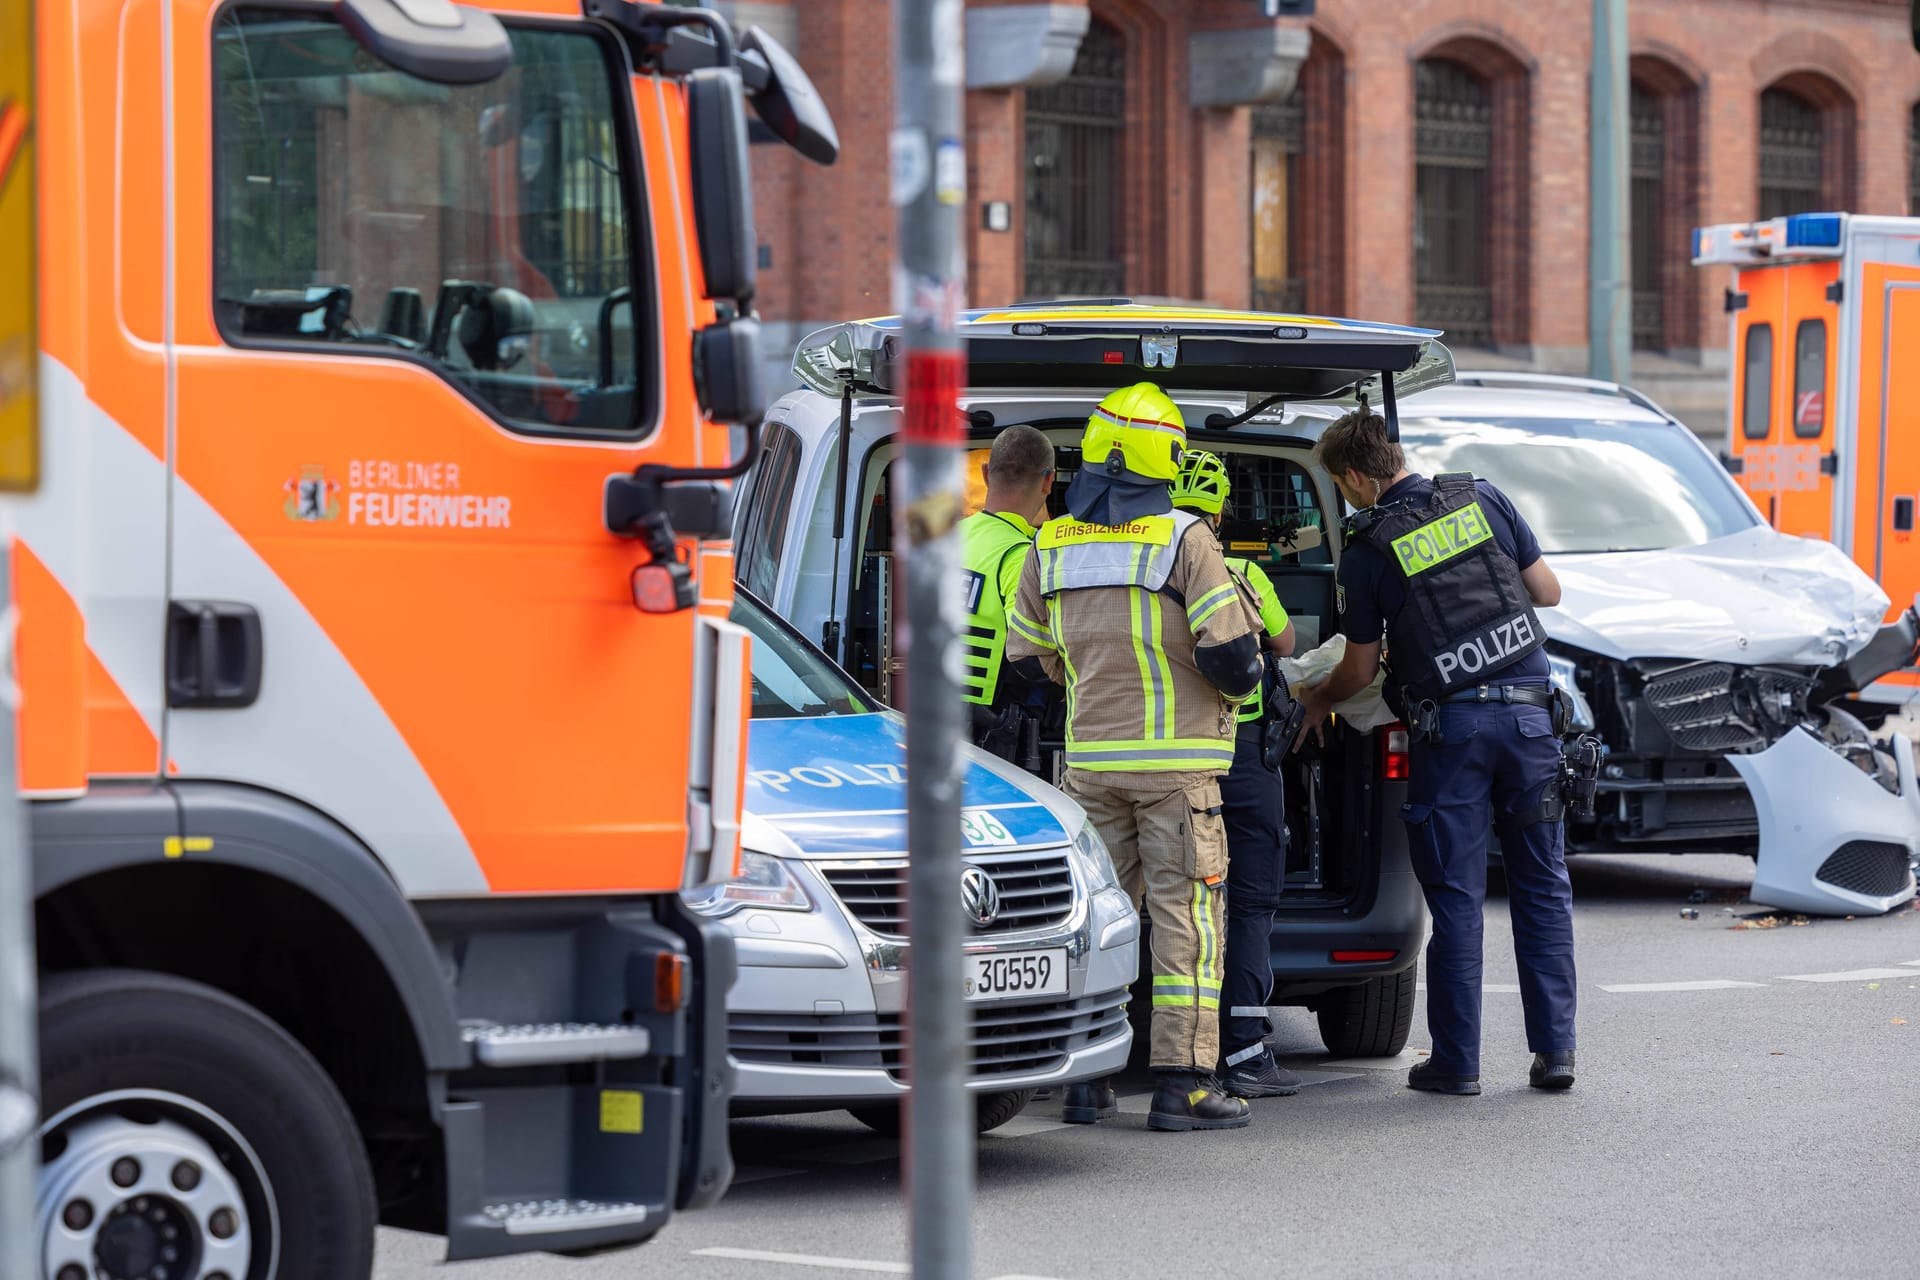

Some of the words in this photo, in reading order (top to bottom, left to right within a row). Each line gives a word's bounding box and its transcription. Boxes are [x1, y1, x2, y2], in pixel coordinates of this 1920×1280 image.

[349, 460, 460, 490] BERLINER
[348, 492, 511, 529] FEUERWEHR
[1396, 507, 1489, 572] POLIZEI
[1434, 612, 1536, 685] POLIZEI
[978, 955, 1052, 993] 30559
